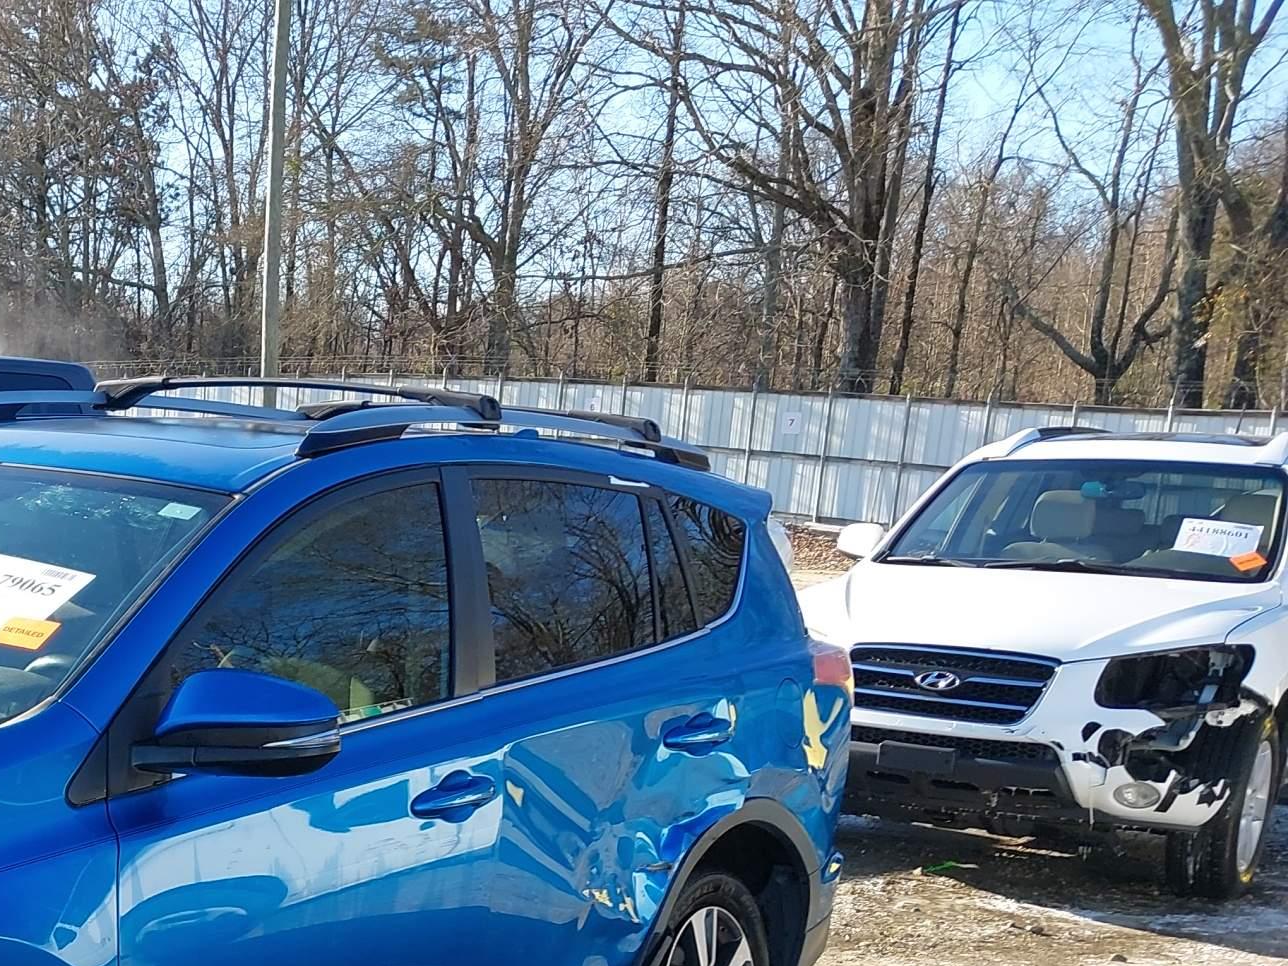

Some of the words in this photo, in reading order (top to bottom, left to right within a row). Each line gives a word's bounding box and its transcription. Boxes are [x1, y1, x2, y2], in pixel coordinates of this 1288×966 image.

[788, 418, 795, 426] 7
[1188, 526, 1249, 539] 44188601
[2, 625, 45, 638] DETAILED
